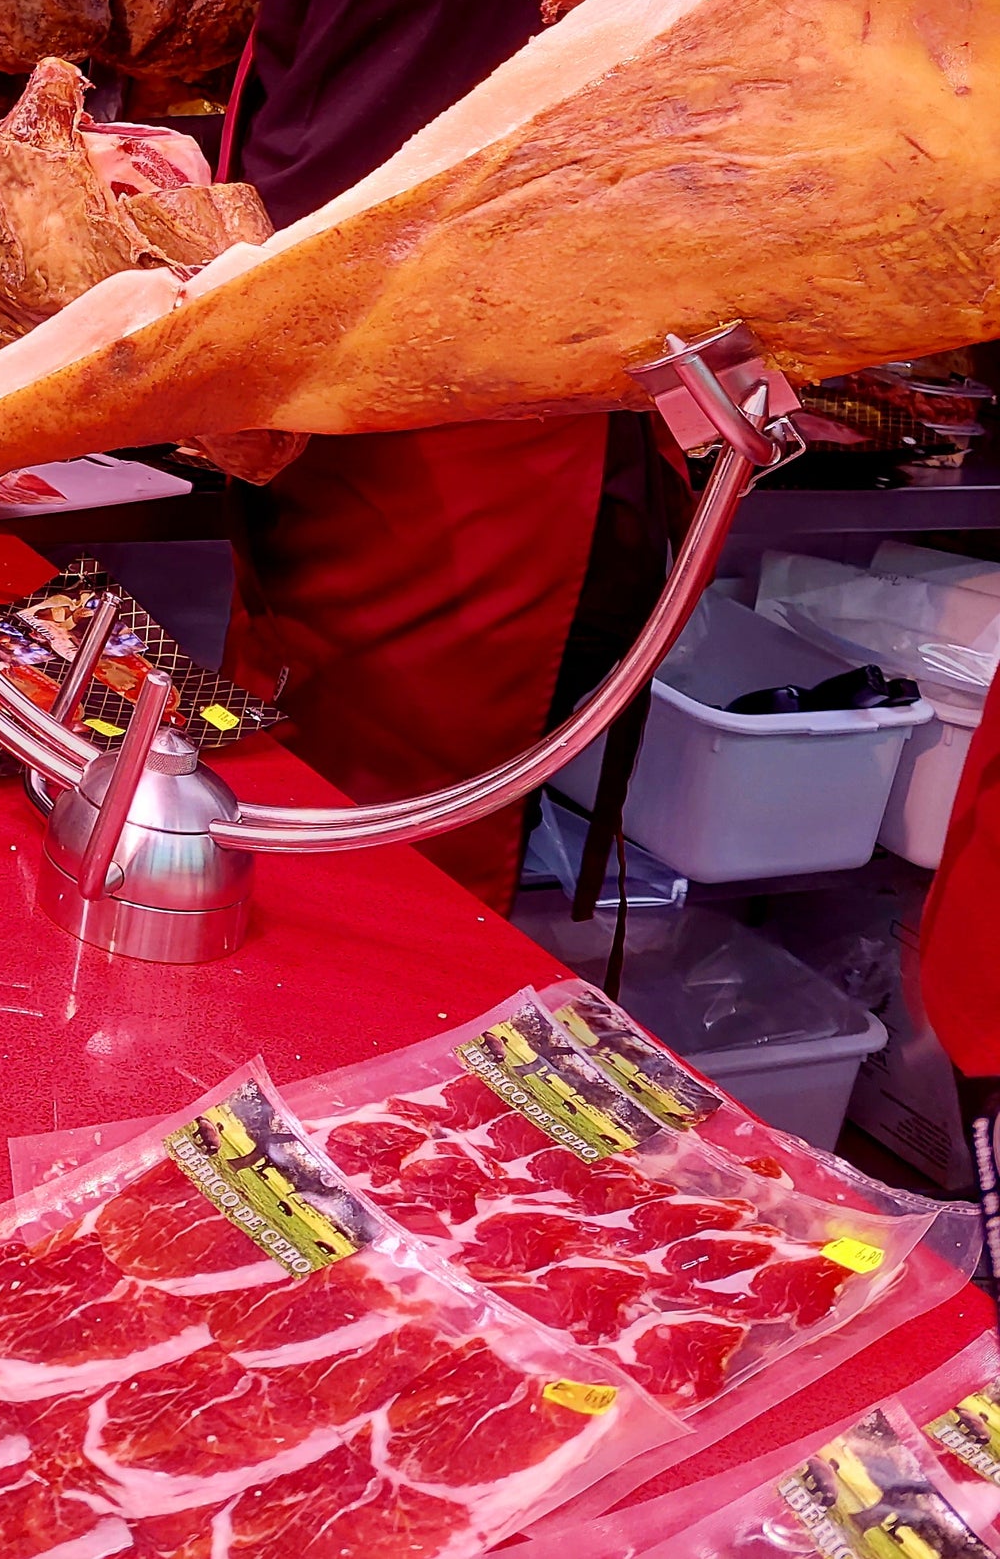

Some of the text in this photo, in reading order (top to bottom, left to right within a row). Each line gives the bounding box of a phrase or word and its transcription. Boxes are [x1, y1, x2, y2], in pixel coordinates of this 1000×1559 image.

[465, 1046, 600, 1159] IBÉRICO DE CEBO
[172, 1135, 312, 1273] IBÉRICO DE CEBO
